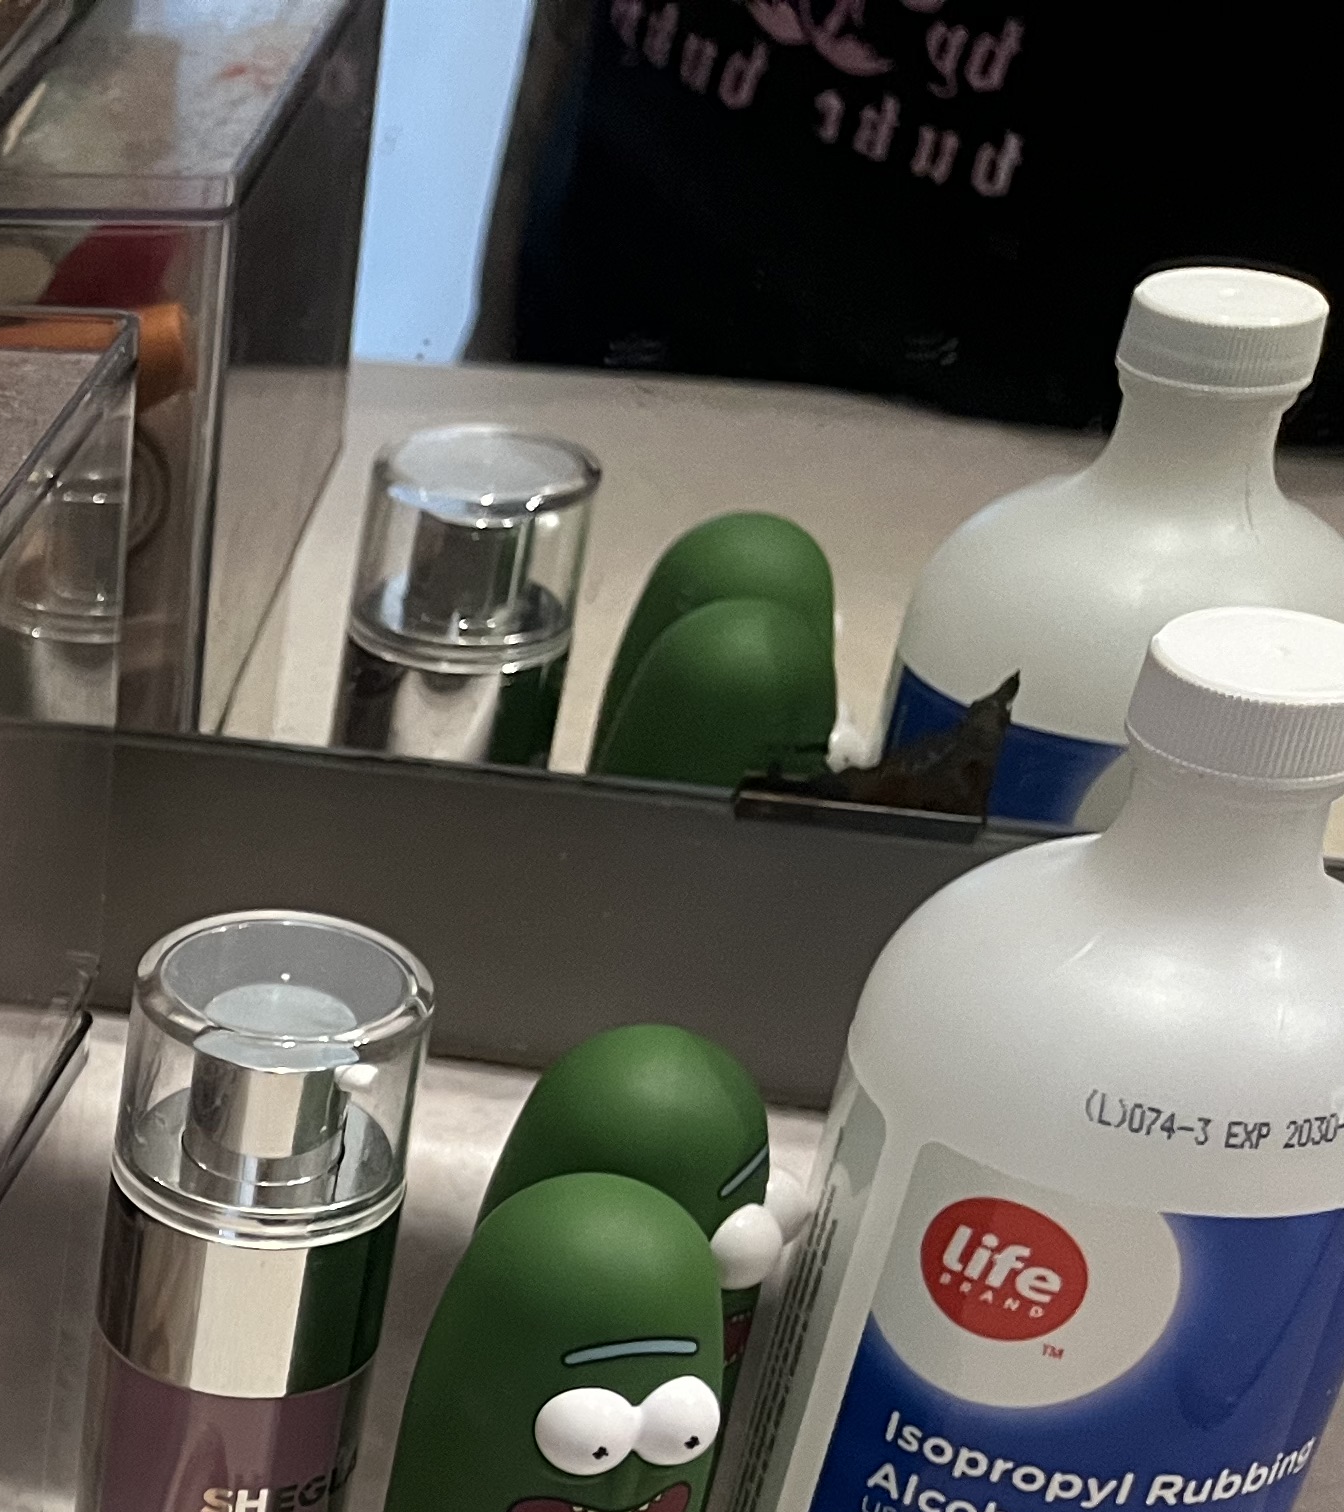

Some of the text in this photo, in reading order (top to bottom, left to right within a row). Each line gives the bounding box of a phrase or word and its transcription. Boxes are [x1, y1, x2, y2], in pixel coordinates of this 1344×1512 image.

[1224, 1120, 1272, 1151] EXP
[884, 1410, 1318, 1510] Isopropyl Rubbing
